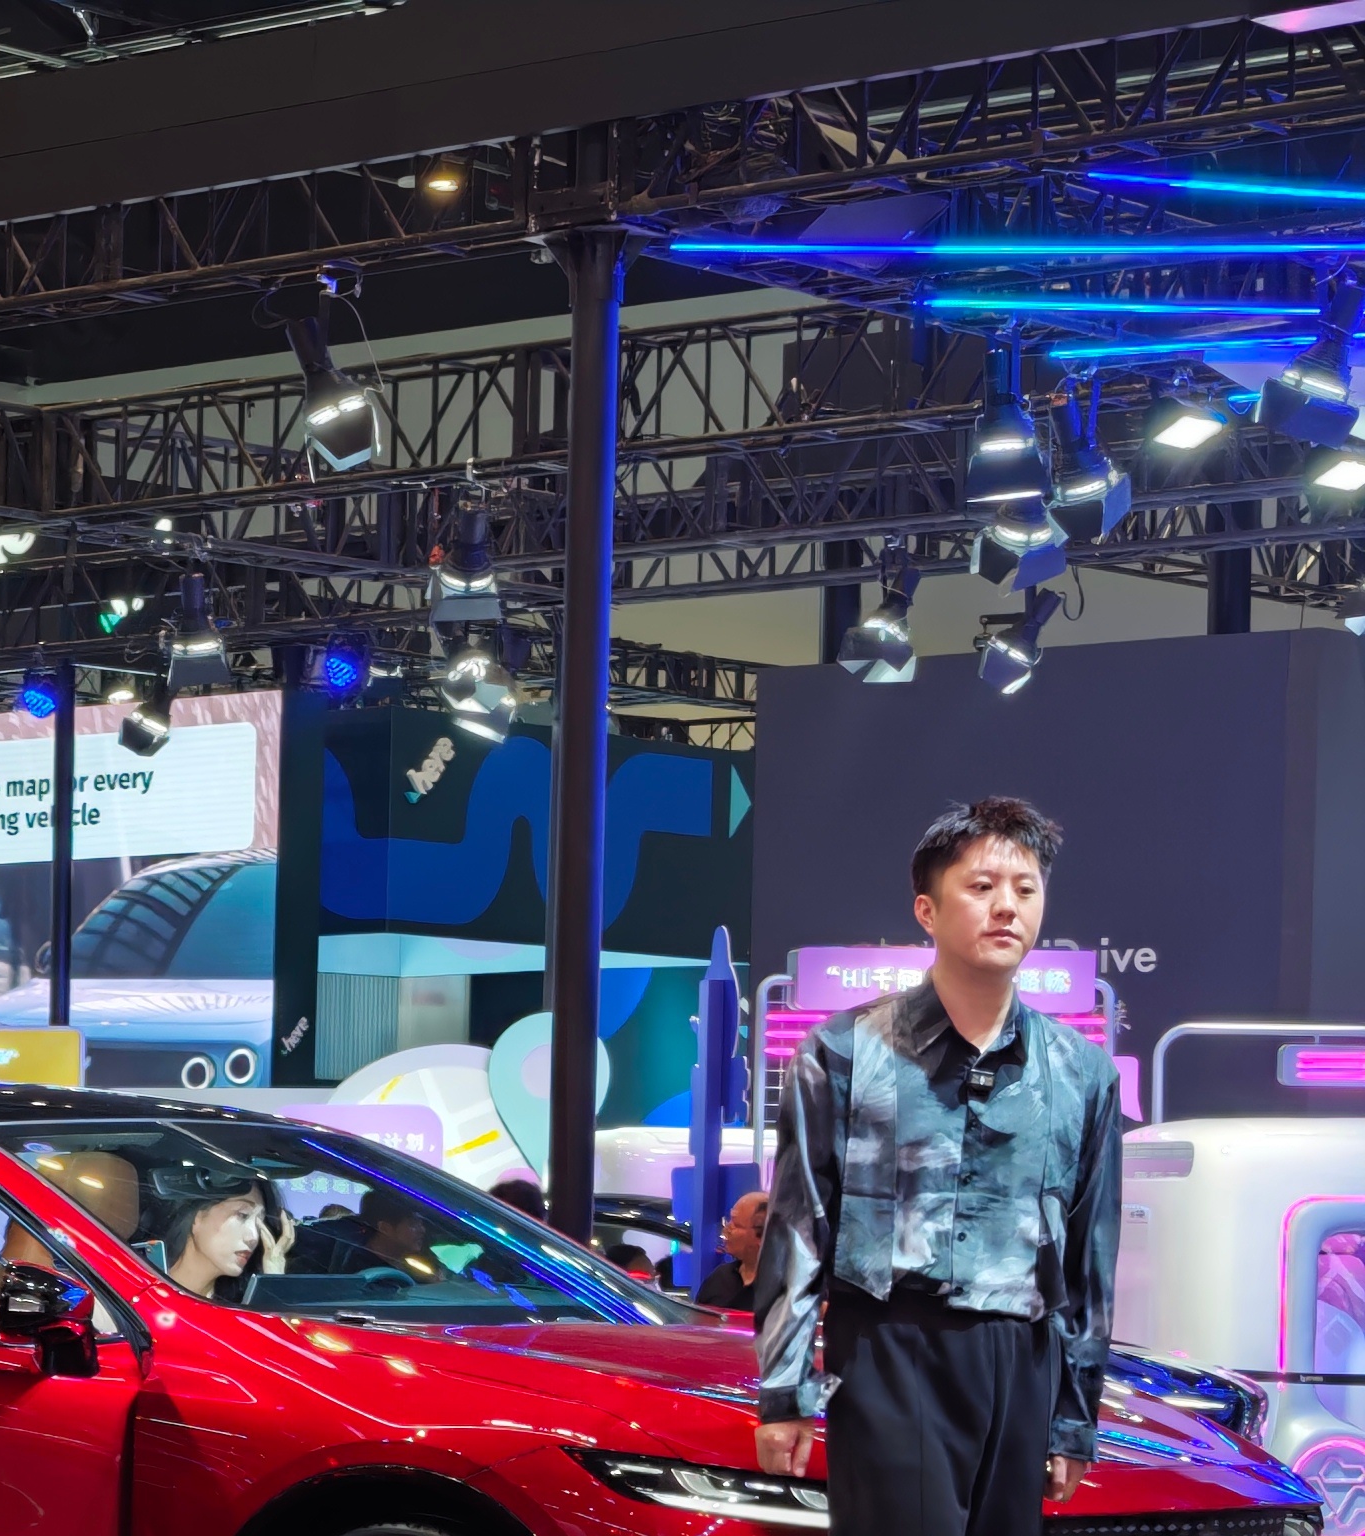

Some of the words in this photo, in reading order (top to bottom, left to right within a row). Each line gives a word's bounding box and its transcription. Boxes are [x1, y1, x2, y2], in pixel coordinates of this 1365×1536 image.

[7, 776, 50, 801] map
[93, 771, 154, 795] every
[25, 803, 101, 829] vecle
